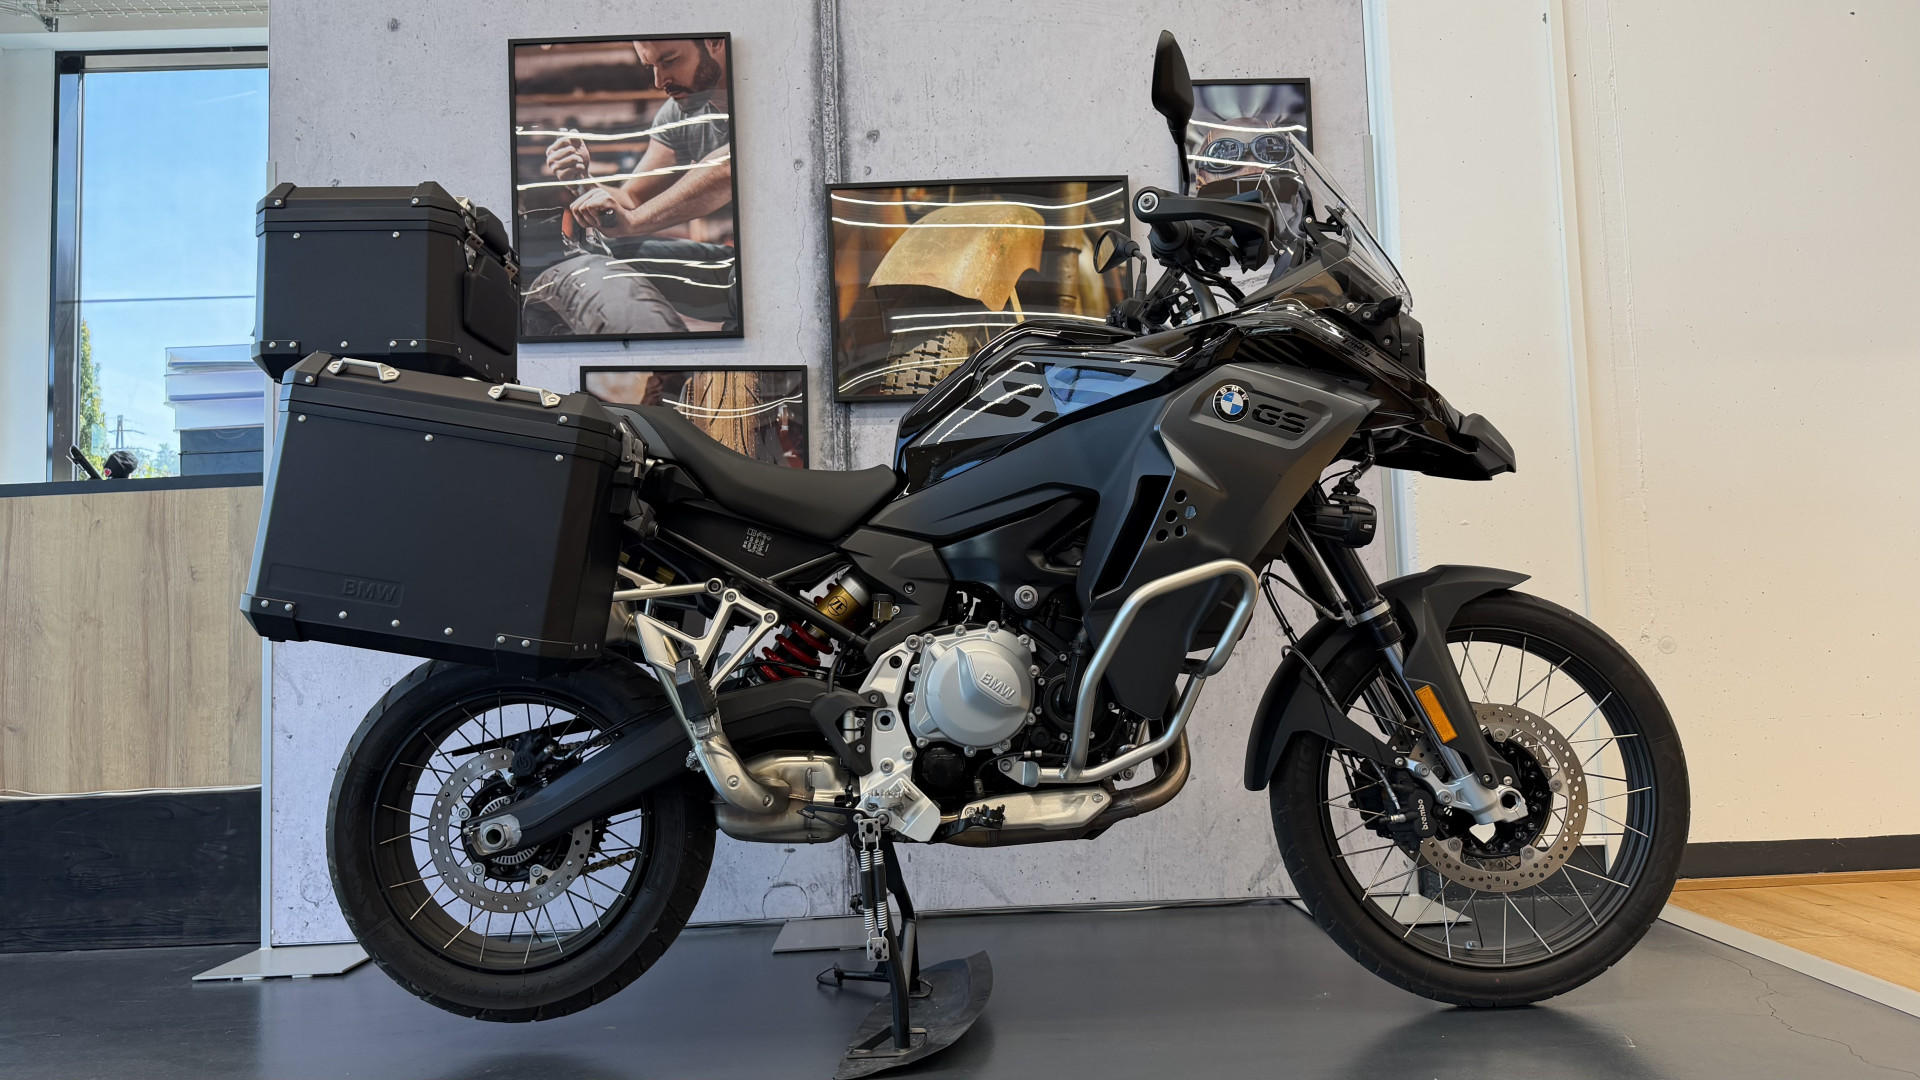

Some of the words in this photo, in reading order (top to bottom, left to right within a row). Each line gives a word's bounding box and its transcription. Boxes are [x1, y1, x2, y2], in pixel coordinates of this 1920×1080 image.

[1252, 404, 1310, 434] GS
[342, 578, 398, 602] BMW
[828, 596, 848, 616] ZF
[980, 670, 1016, 700] BMW
[1417, 798, 1429, 831] brembo
